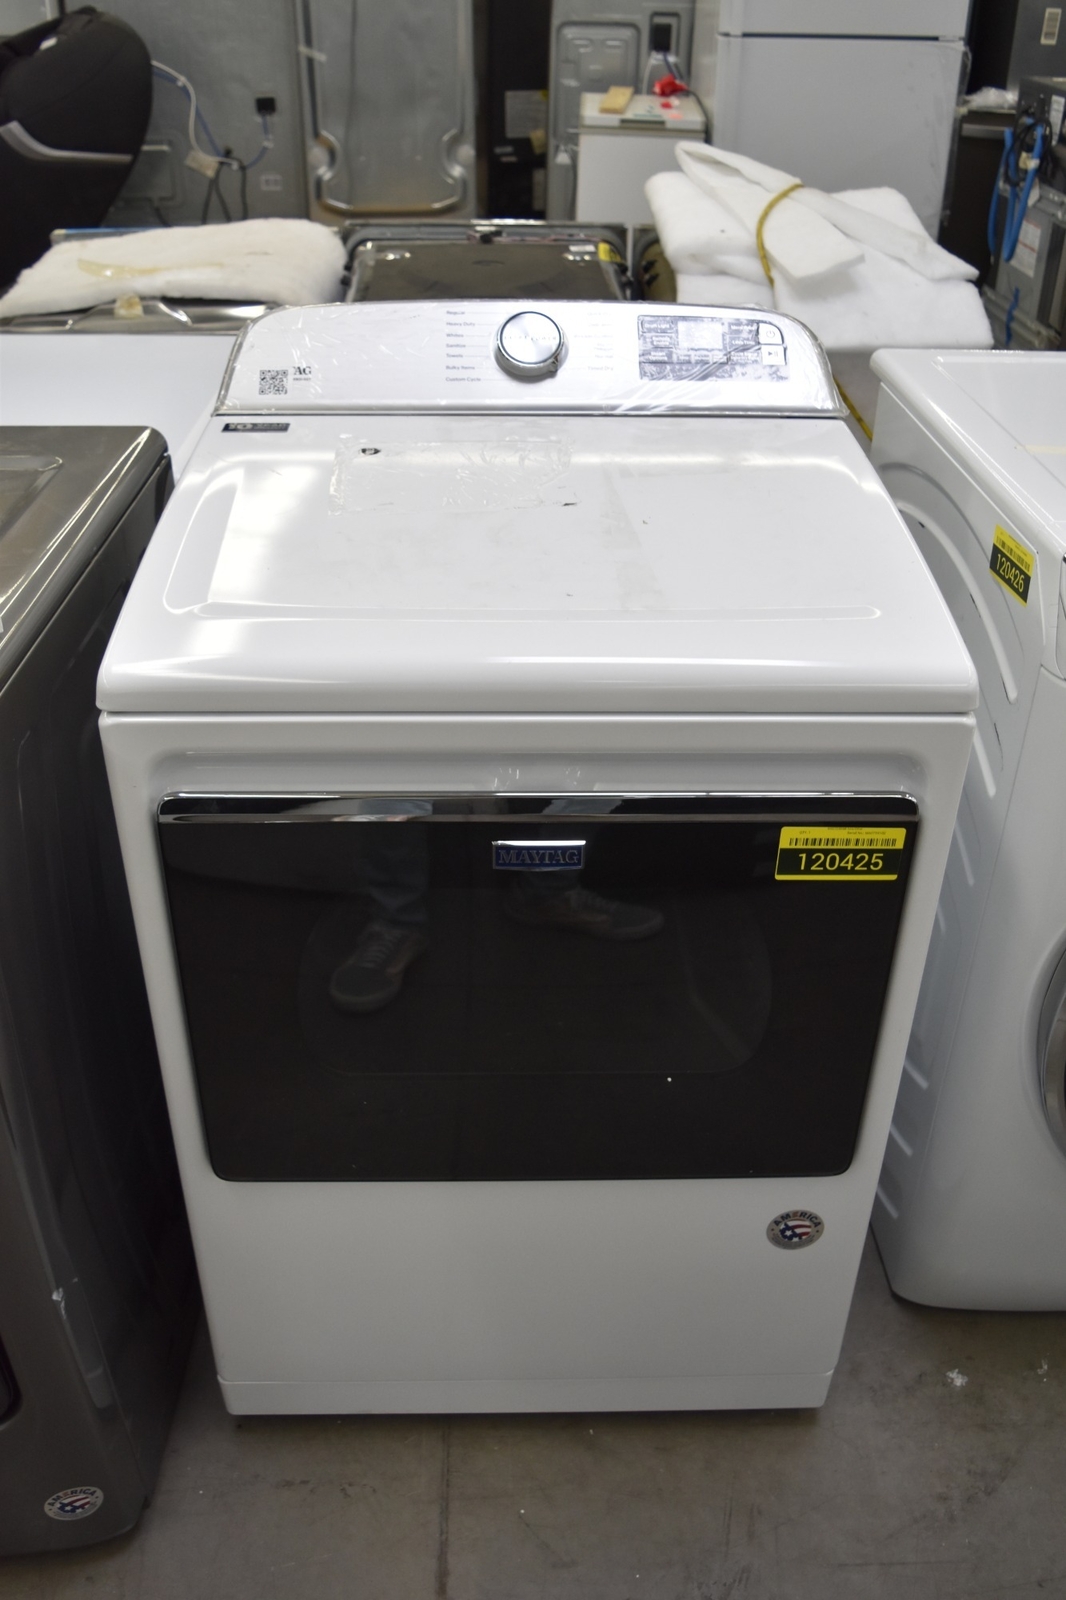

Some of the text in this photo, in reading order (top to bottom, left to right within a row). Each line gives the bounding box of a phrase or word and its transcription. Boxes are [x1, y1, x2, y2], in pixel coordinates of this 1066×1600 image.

[996, 553, 1025, 592] 120426
[498, 849, 580, 864] MAYTAG
[798, 853, 884, 871] 120425
[773, 1211, 822, 1228] AMERICA
[47, 1488, 97, 1507] AMERICA
